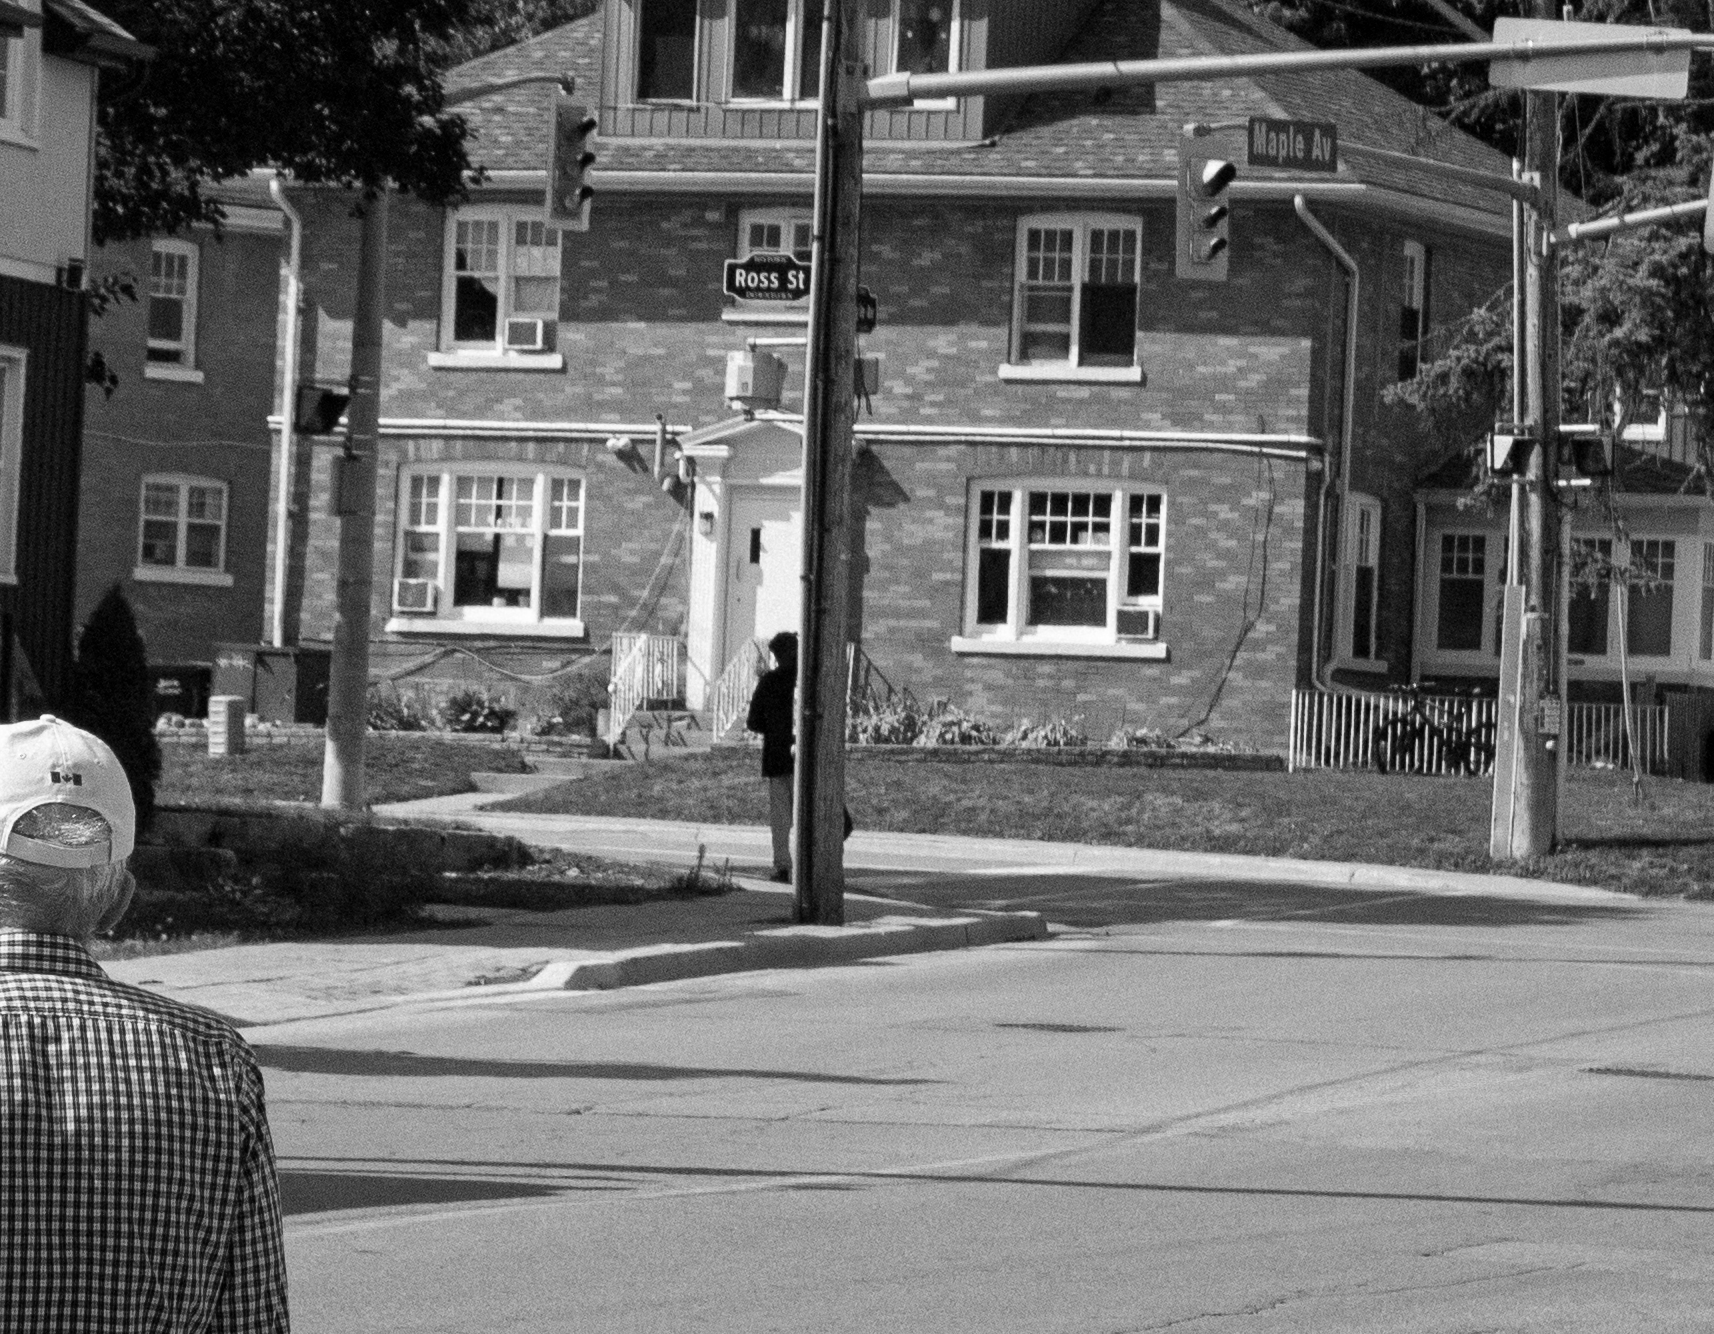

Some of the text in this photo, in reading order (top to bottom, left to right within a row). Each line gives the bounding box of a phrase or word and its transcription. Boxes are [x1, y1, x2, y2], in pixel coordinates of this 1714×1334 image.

[1253, 121, 1331, 164] Maple Av
[734, 267, 805, 290] Ross St
